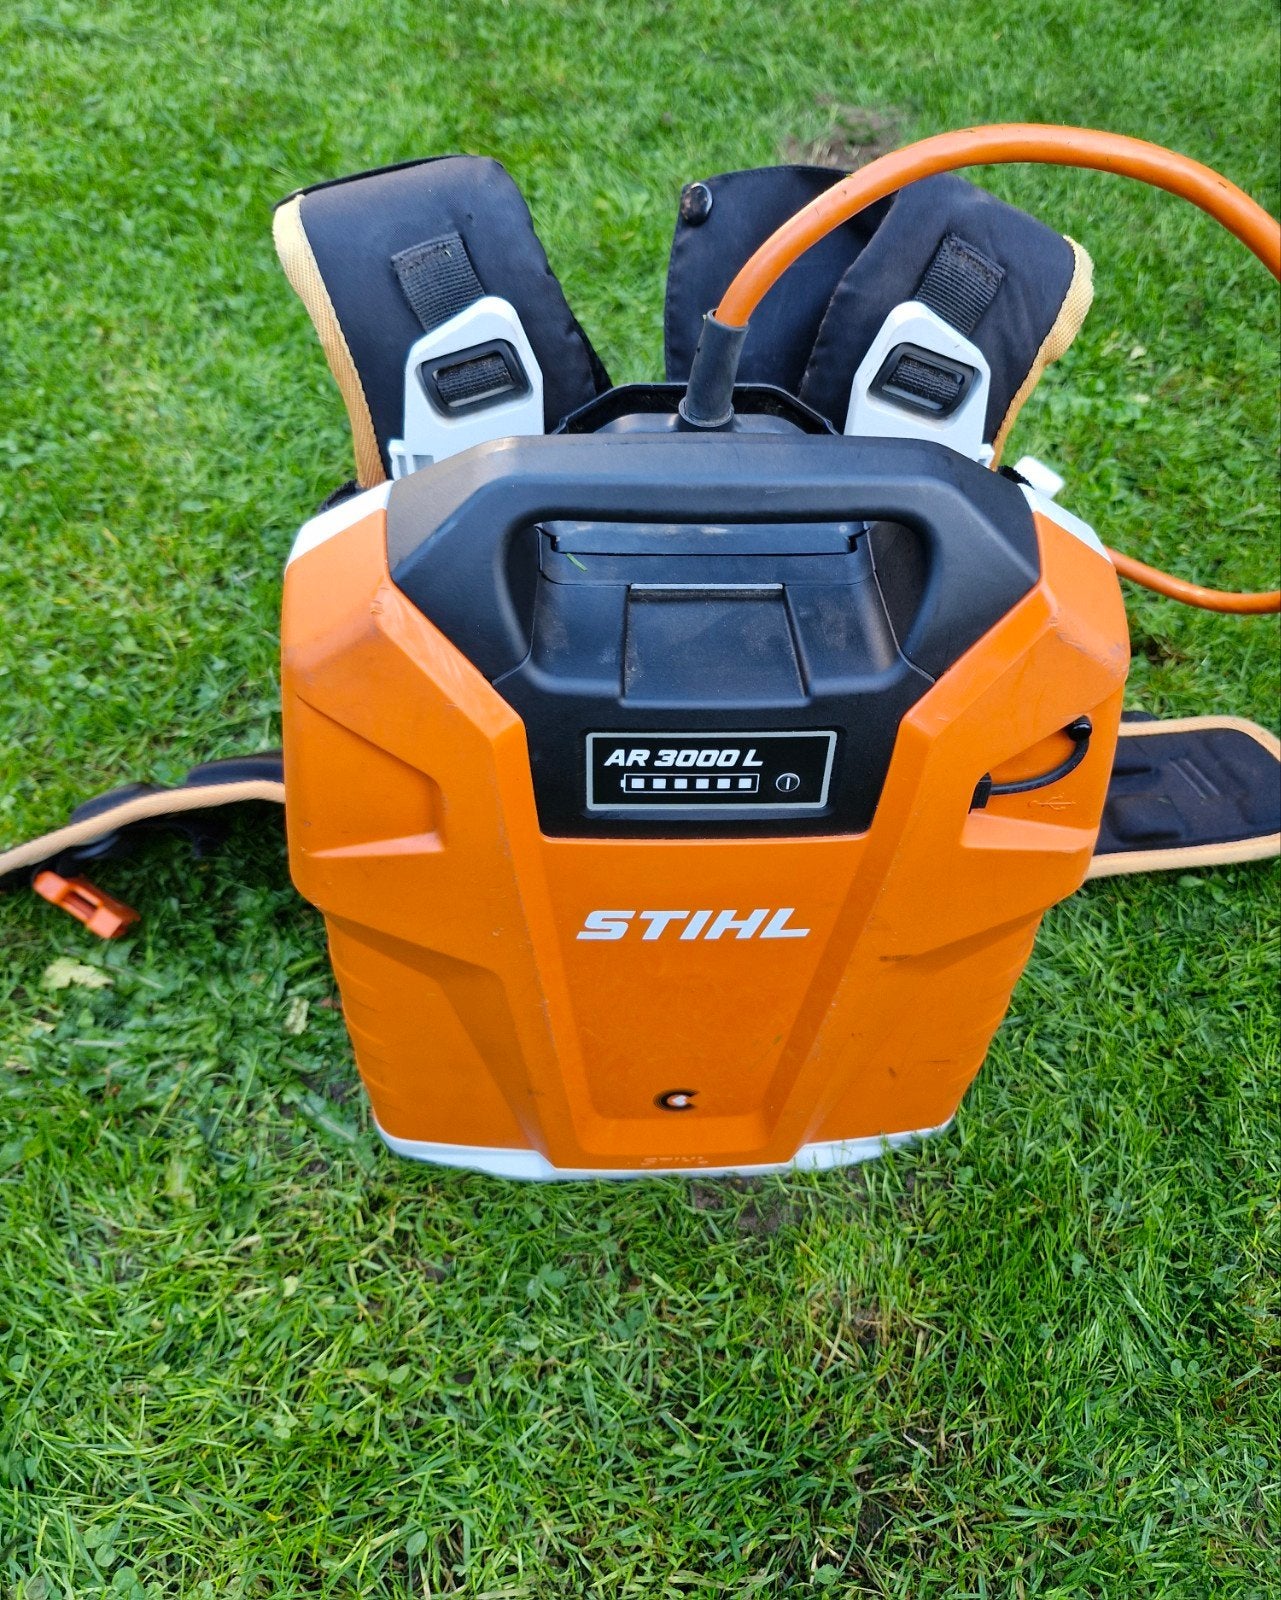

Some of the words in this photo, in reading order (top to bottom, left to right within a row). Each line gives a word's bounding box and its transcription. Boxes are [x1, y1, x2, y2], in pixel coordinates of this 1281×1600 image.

[604, 749, 650, 767] AR
[654, 749, 741, 767] 3000
[742, 748, 763, 767] L
[576, 907, 811, 941] STIHL
